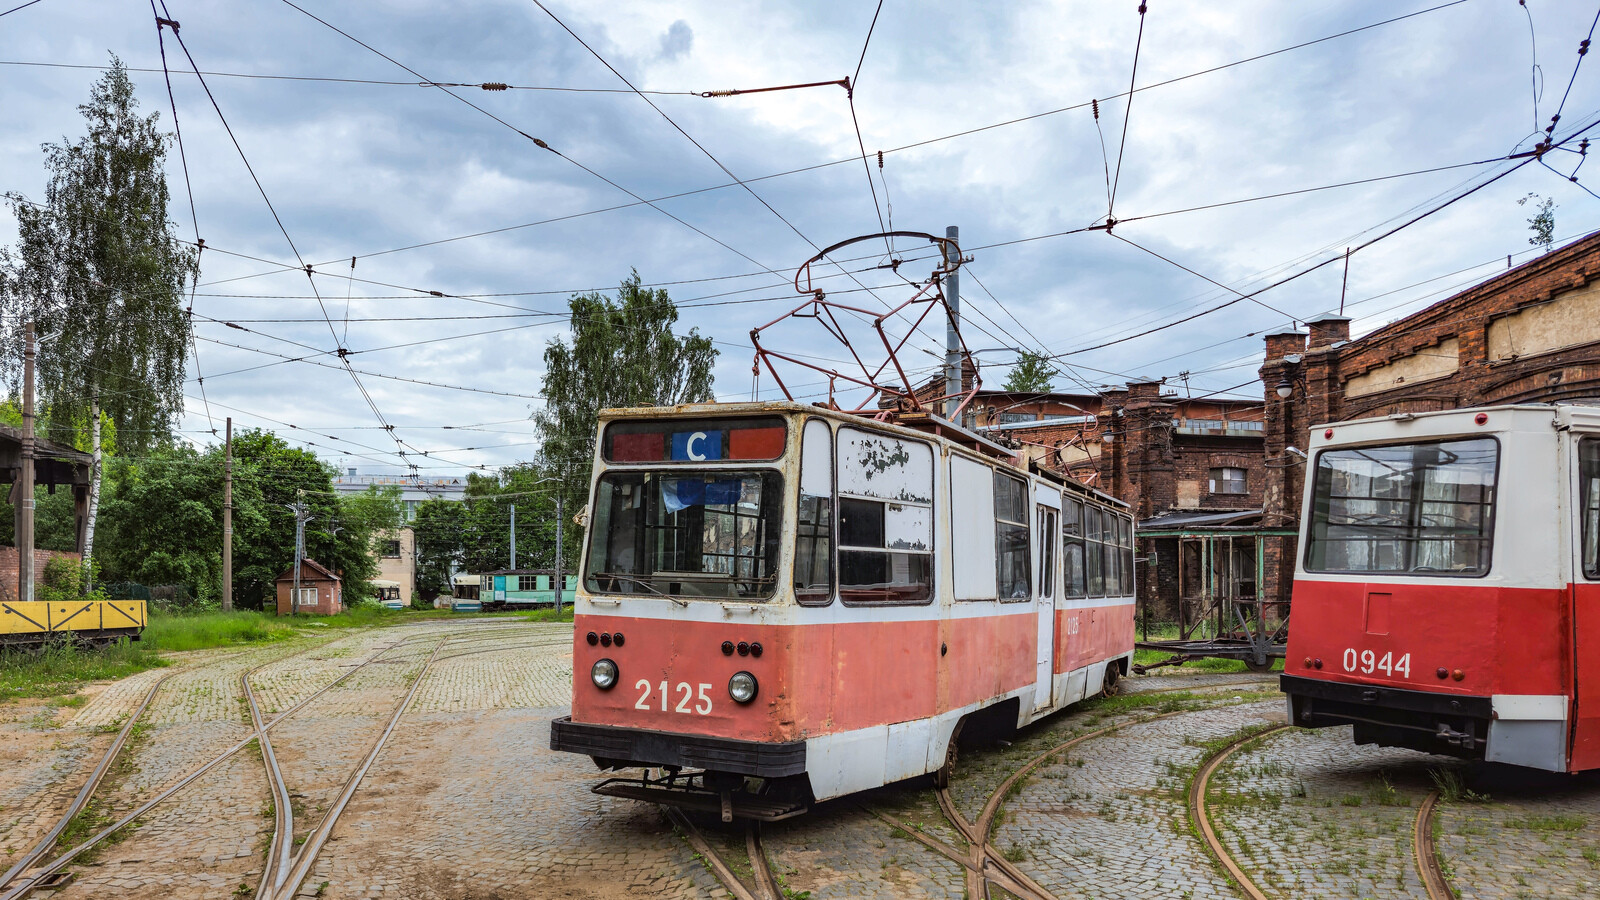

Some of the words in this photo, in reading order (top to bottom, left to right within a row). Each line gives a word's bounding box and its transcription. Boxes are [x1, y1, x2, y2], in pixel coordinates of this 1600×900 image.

[1067, 617, 1079, 635] 2125
[1343, 648, 1411, 678] 0944
[634, 678, 713, 716] 2125
